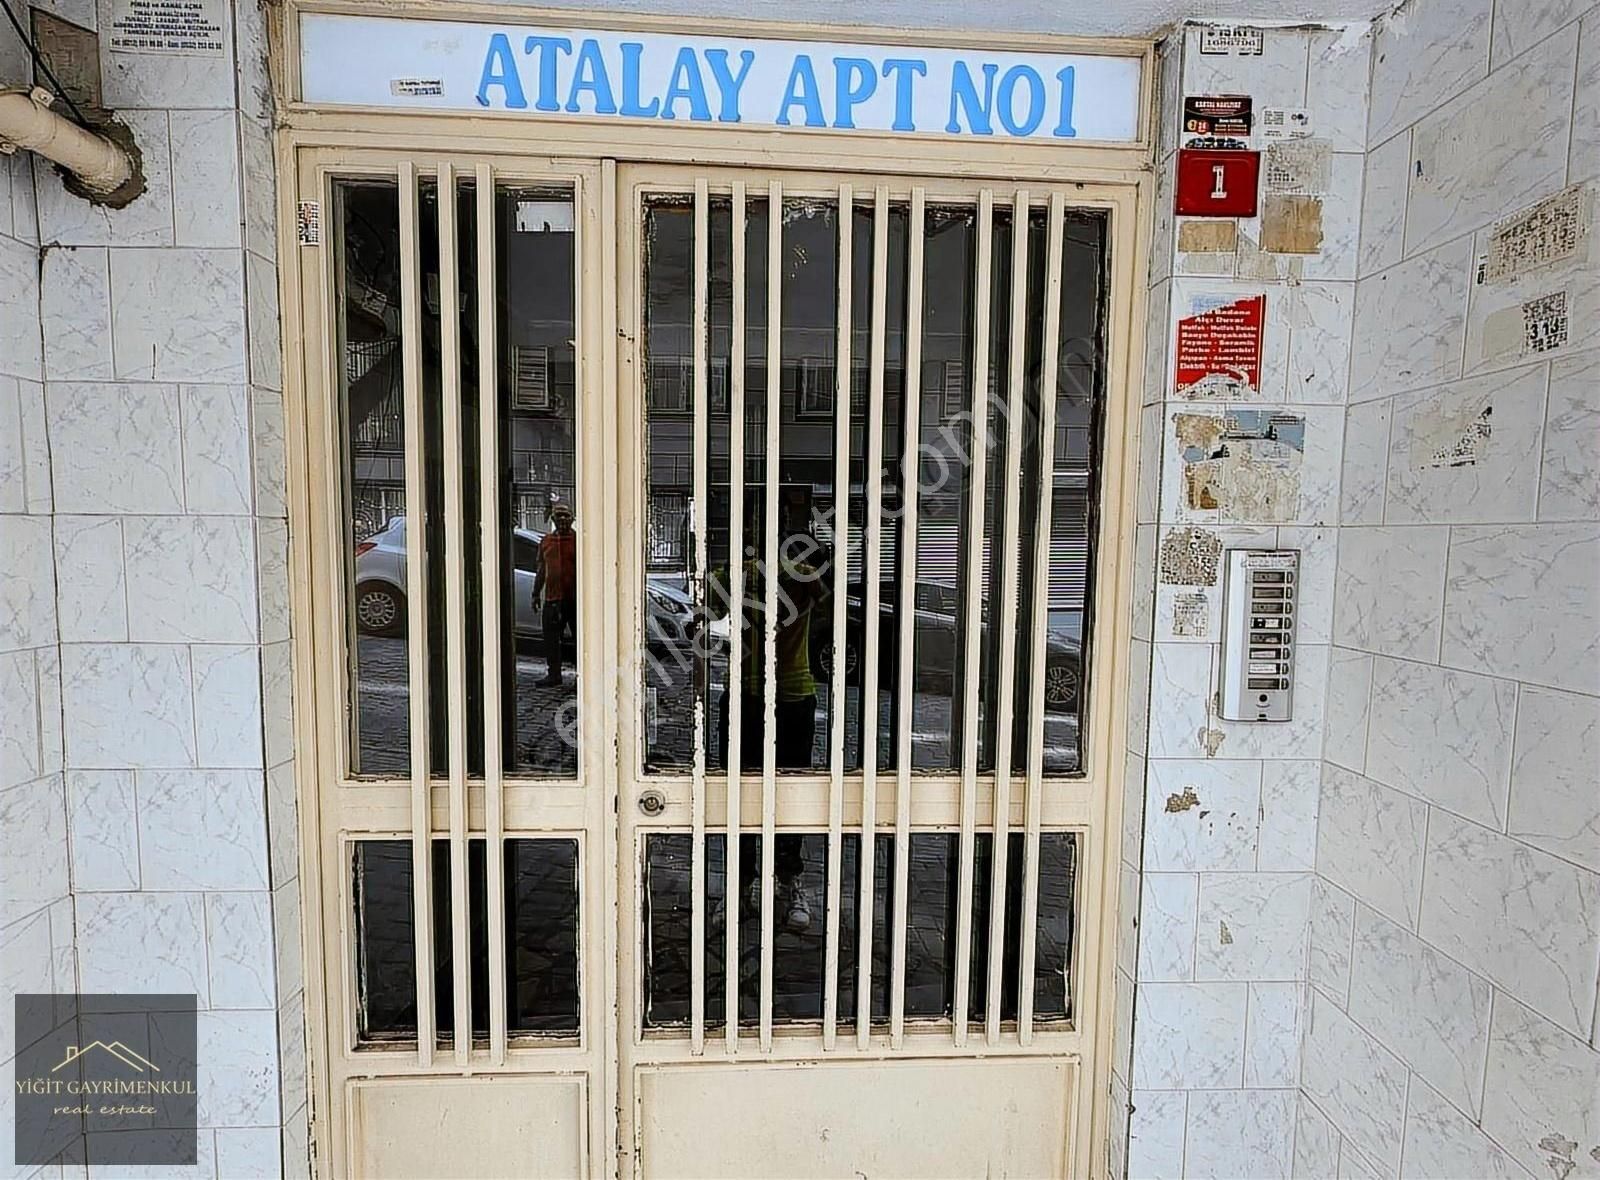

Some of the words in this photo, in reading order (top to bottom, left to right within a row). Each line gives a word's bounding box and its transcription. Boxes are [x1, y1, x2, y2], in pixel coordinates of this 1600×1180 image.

[476, 33, 756, 123] ATALAY
[776, 54, 927, 132] APT
[945, 60, 1077, 137] NO1
[1210, 165, 1228, 199] 1
